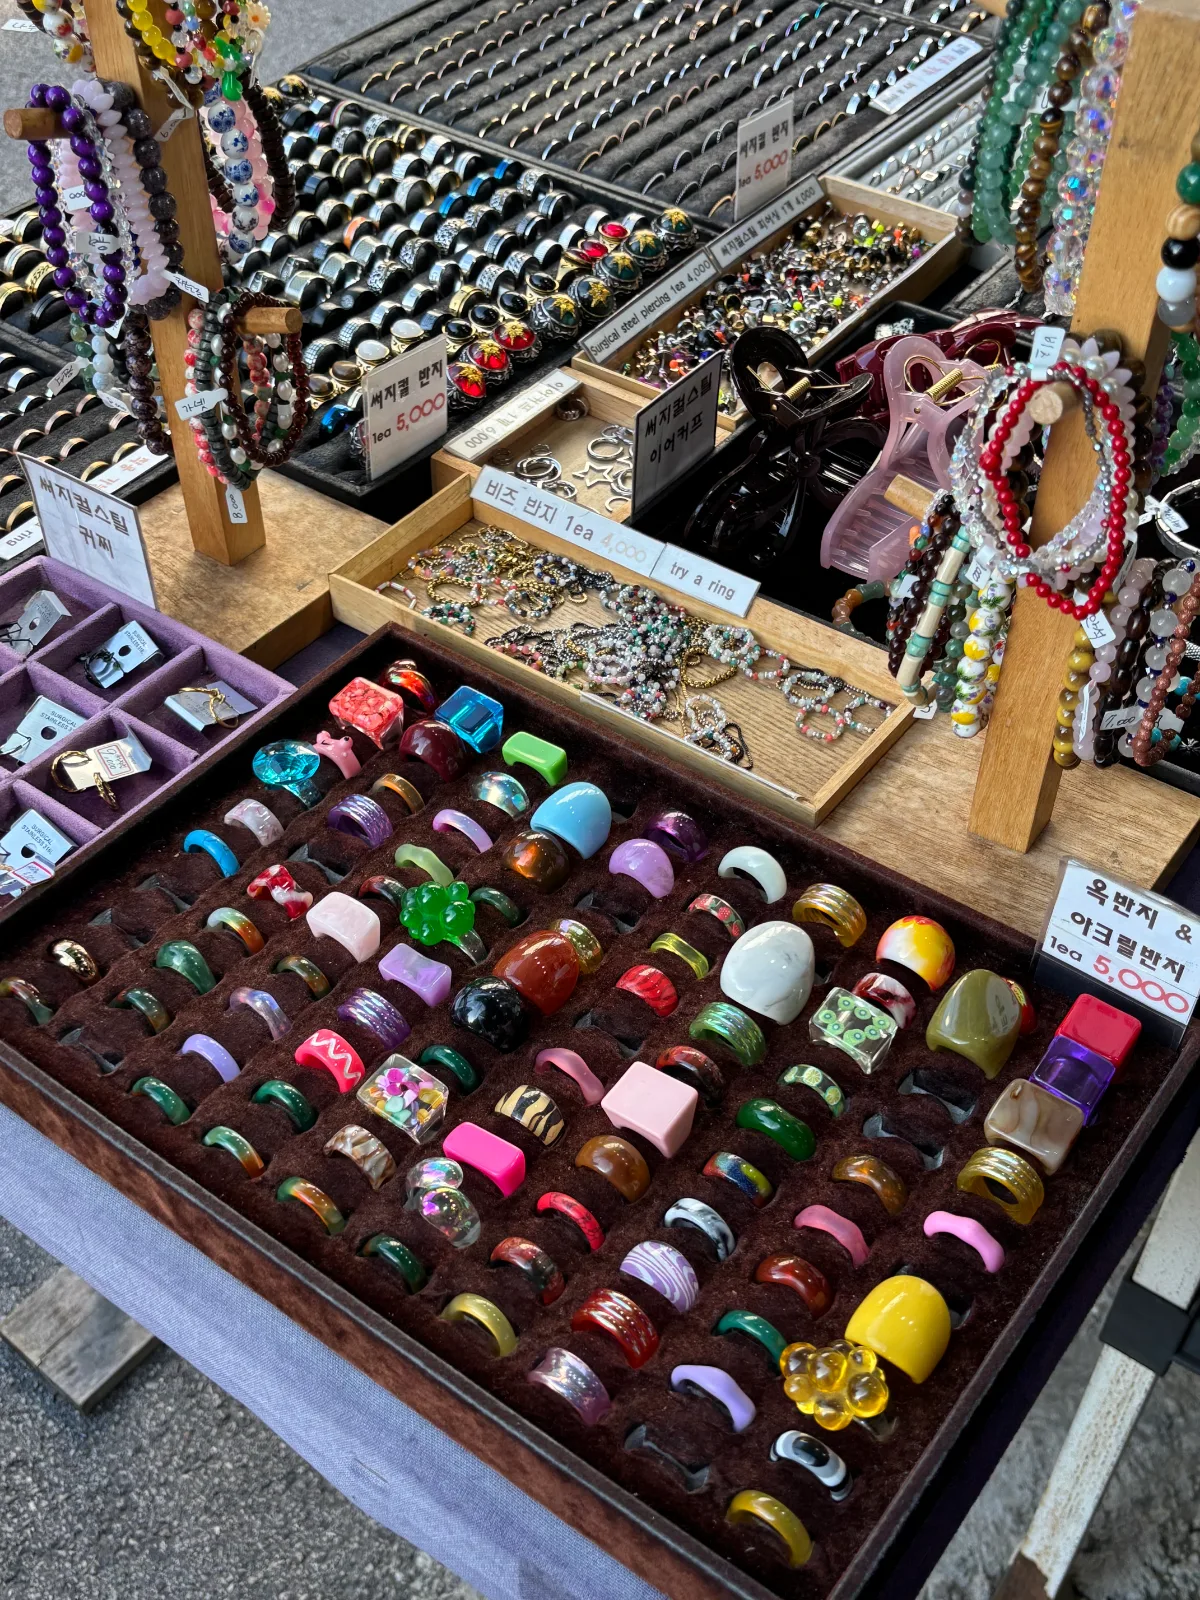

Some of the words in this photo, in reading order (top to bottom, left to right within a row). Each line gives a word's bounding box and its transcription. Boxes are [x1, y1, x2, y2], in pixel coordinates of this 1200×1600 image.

[739, 131, 766, 158] 써지컬
[772, 119, 789, 144] 반지
[754, 149, 788, 181] 5,000
[757, 209, 781, 230] 피어싱
[795, 186, 816, 206] 4,000
[590, 328, 621, 356] Surgical
[621, 313, 640, 333] steel
[640, 293, 671, 320] piercing
[670, 283, 687, 295] 1ea
[687, 259, 711, 283] 4,000
[371, 376, 410, 410] 써지컬
[418, 359, 443, 389] 반지
[645, 372, 712, 438] 써지컬스틸
[372, 427, 391, 444] 1ea
[396, 392, 445, 431] 5,000
[650, 411, 703, 464] 이어커프
[39, 476, 129, 536] 써지컬스틸
[485, 479, 519, 506] 비즈
[523, 496, 558, 525] 반지
[565, 516, 594, 542] 1ea
[600, 533, 647, 563] 4,000
[6, 530, 33, 547] ring
[78, 525, 114, 559] 귀찌
[670, 562, 689, 580] try
[693, 574, 703, 586] a
[707, 580, 736, 600] ring
[40, 712, 68, 730] STAINLESS
[51, 711, 77, 728] SURGICAL
[21, 824, 43, 846] STAINLESS
[31, 824, 53, 845] SURGICAL
[1085, 878, 1158, 930] 옥반지
[1174, 924, 1192, 945] &
[1070, 911, 1185, 984] 아크릴반지
[1050, 935, 1083, 962] 1ea
[1093, 954, 1189, 1014] 5,000
